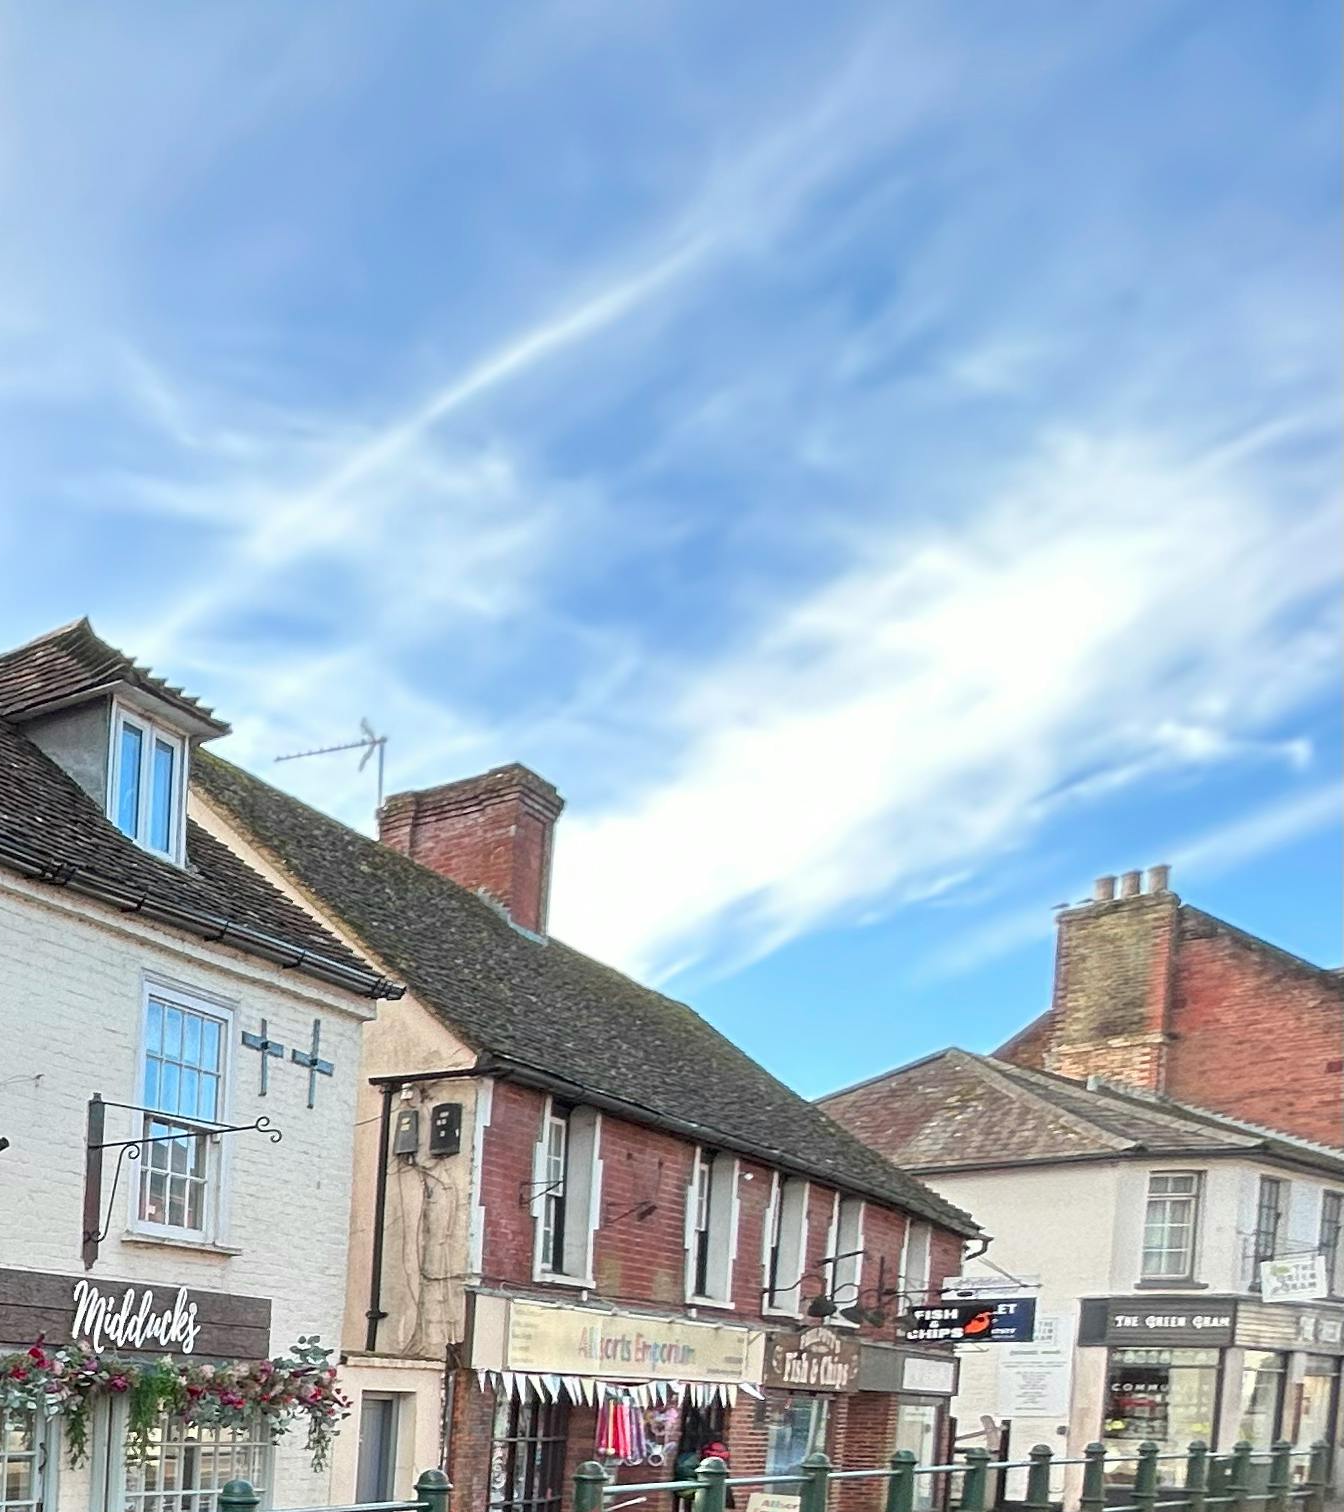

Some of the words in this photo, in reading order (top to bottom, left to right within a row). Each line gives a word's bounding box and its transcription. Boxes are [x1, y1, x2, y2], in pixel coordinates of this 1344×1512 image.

[914, 1308, 960, 1320] FISH
[1114, 1315, 1140, 1328] THE
[906, 1327, 965, 1340] CHIPS
[783, 1352, 809, 1384] Fish
